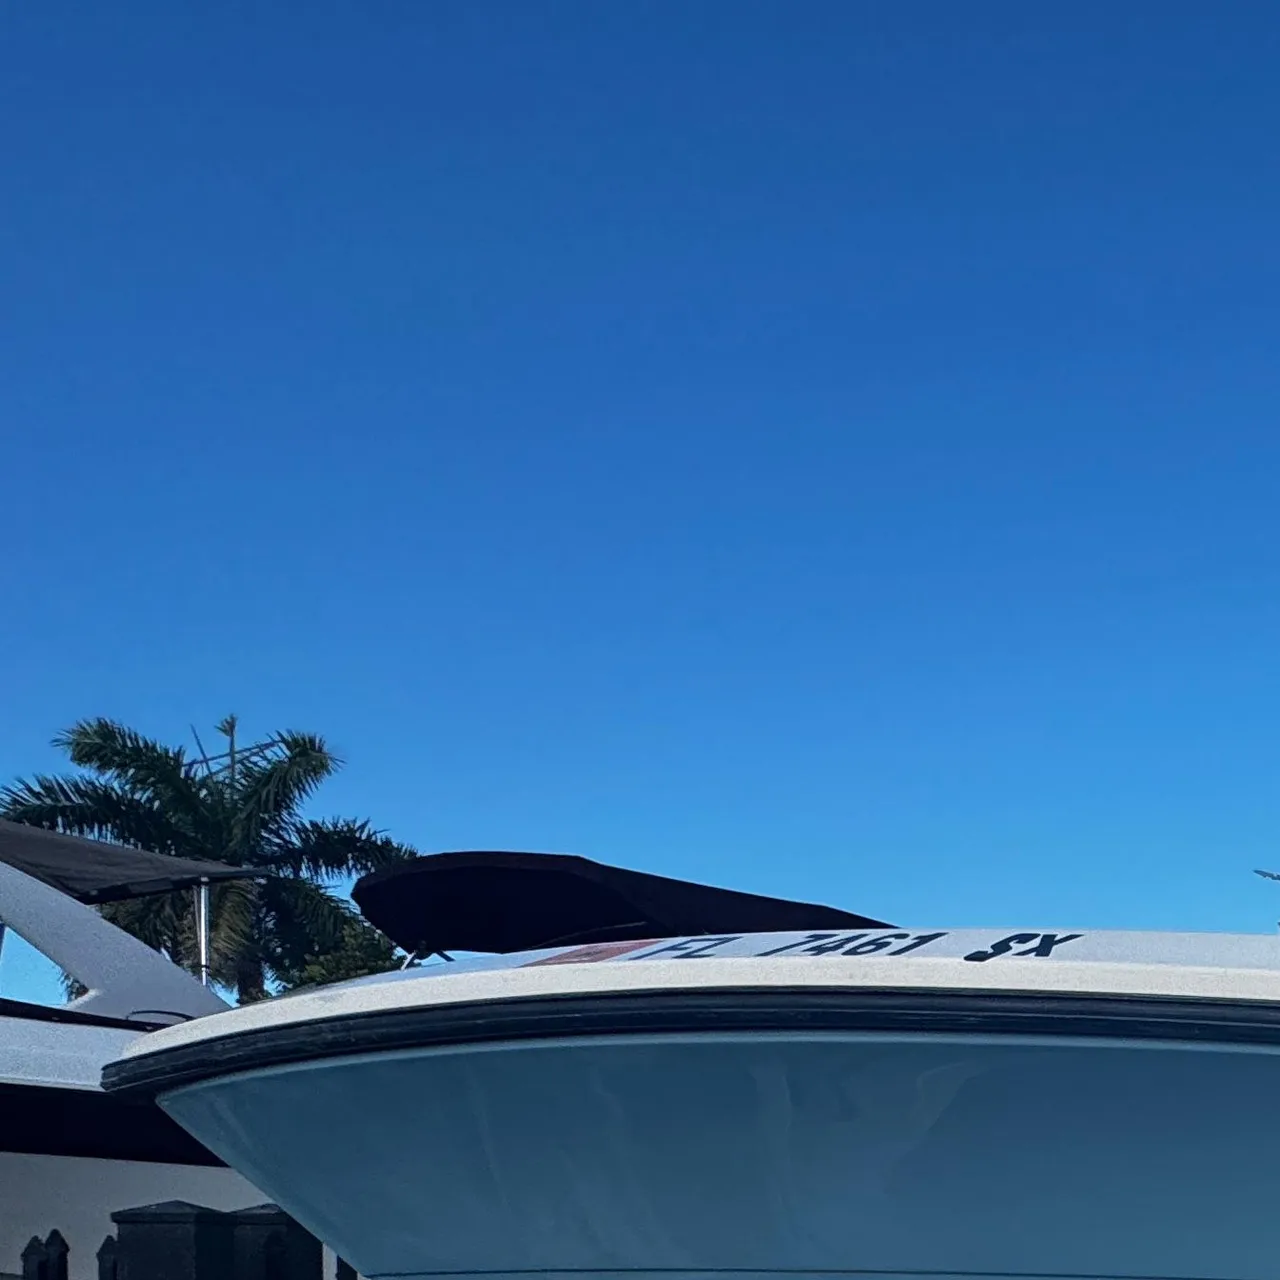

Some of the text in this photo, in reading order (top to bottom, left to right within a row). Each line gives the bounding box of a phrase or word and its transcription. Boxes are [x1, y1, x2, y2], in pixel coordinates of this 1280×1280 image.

[628, 931, 1085, 962] FL 7461 SX
